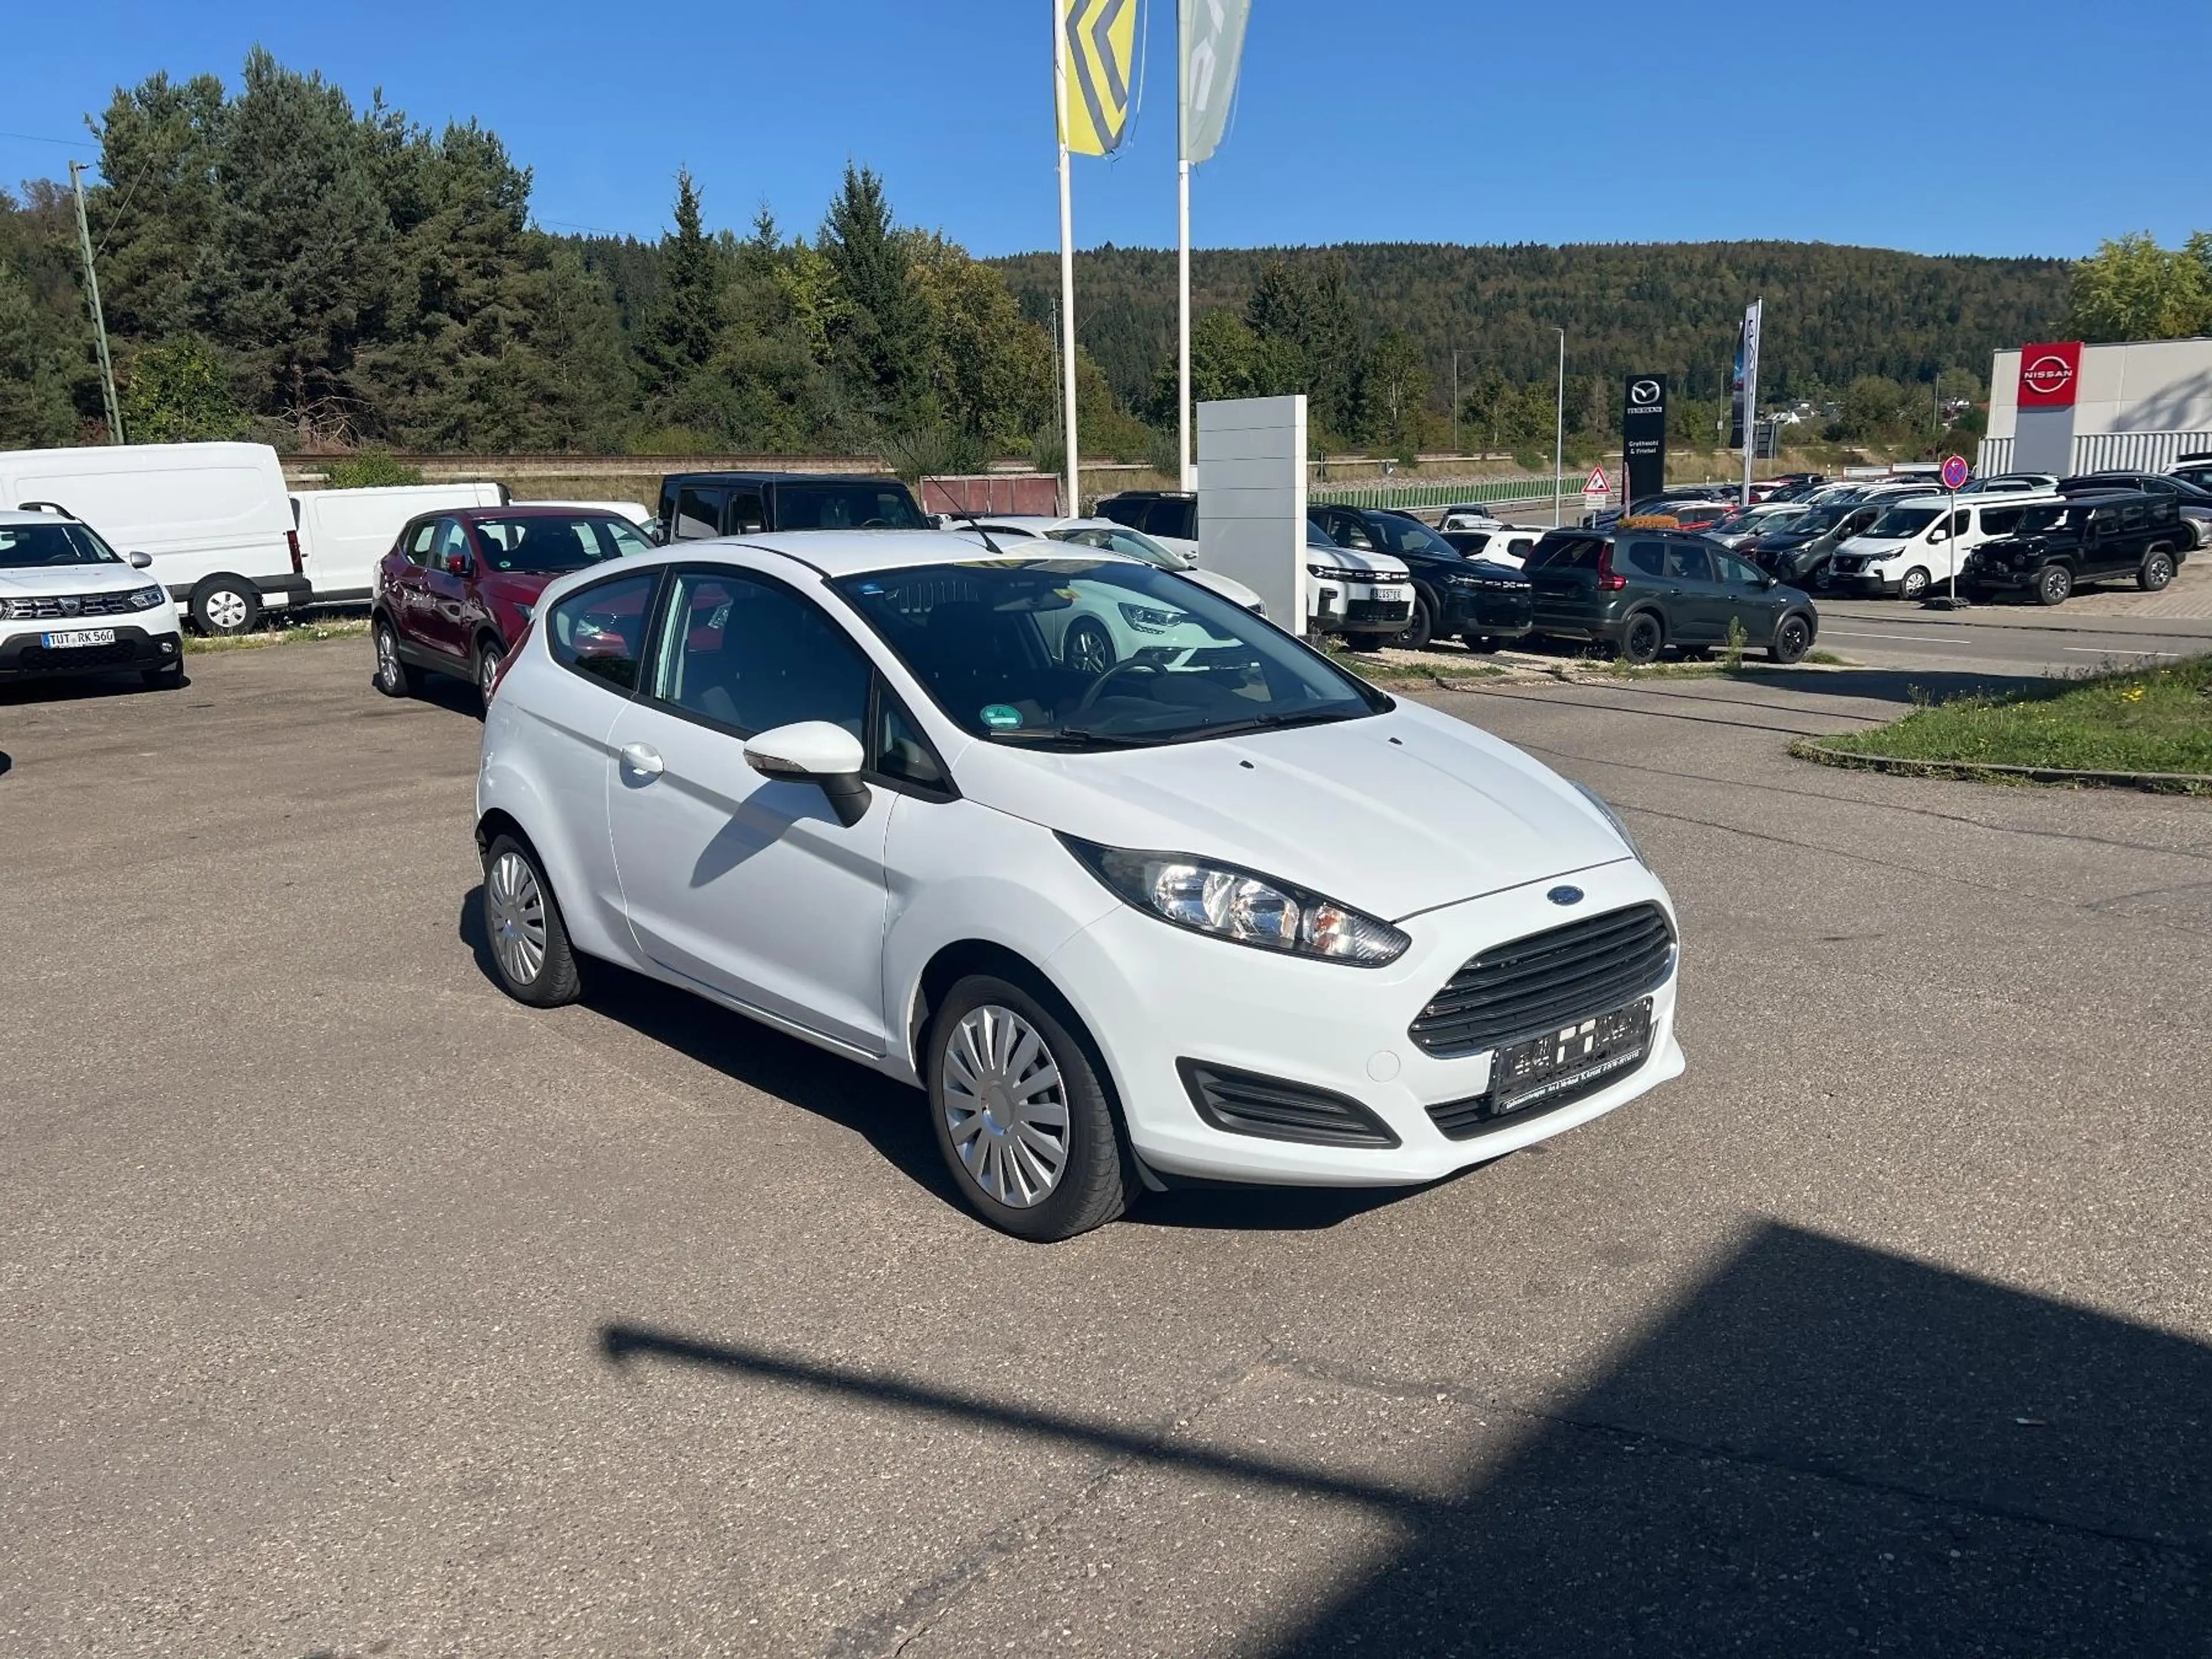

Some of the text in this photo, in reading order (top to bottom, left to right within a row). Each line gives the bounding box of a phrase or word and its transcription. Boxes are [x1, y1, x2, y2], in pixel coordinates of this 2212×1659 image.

[50, 631, 113, 645] TUT RK 560
